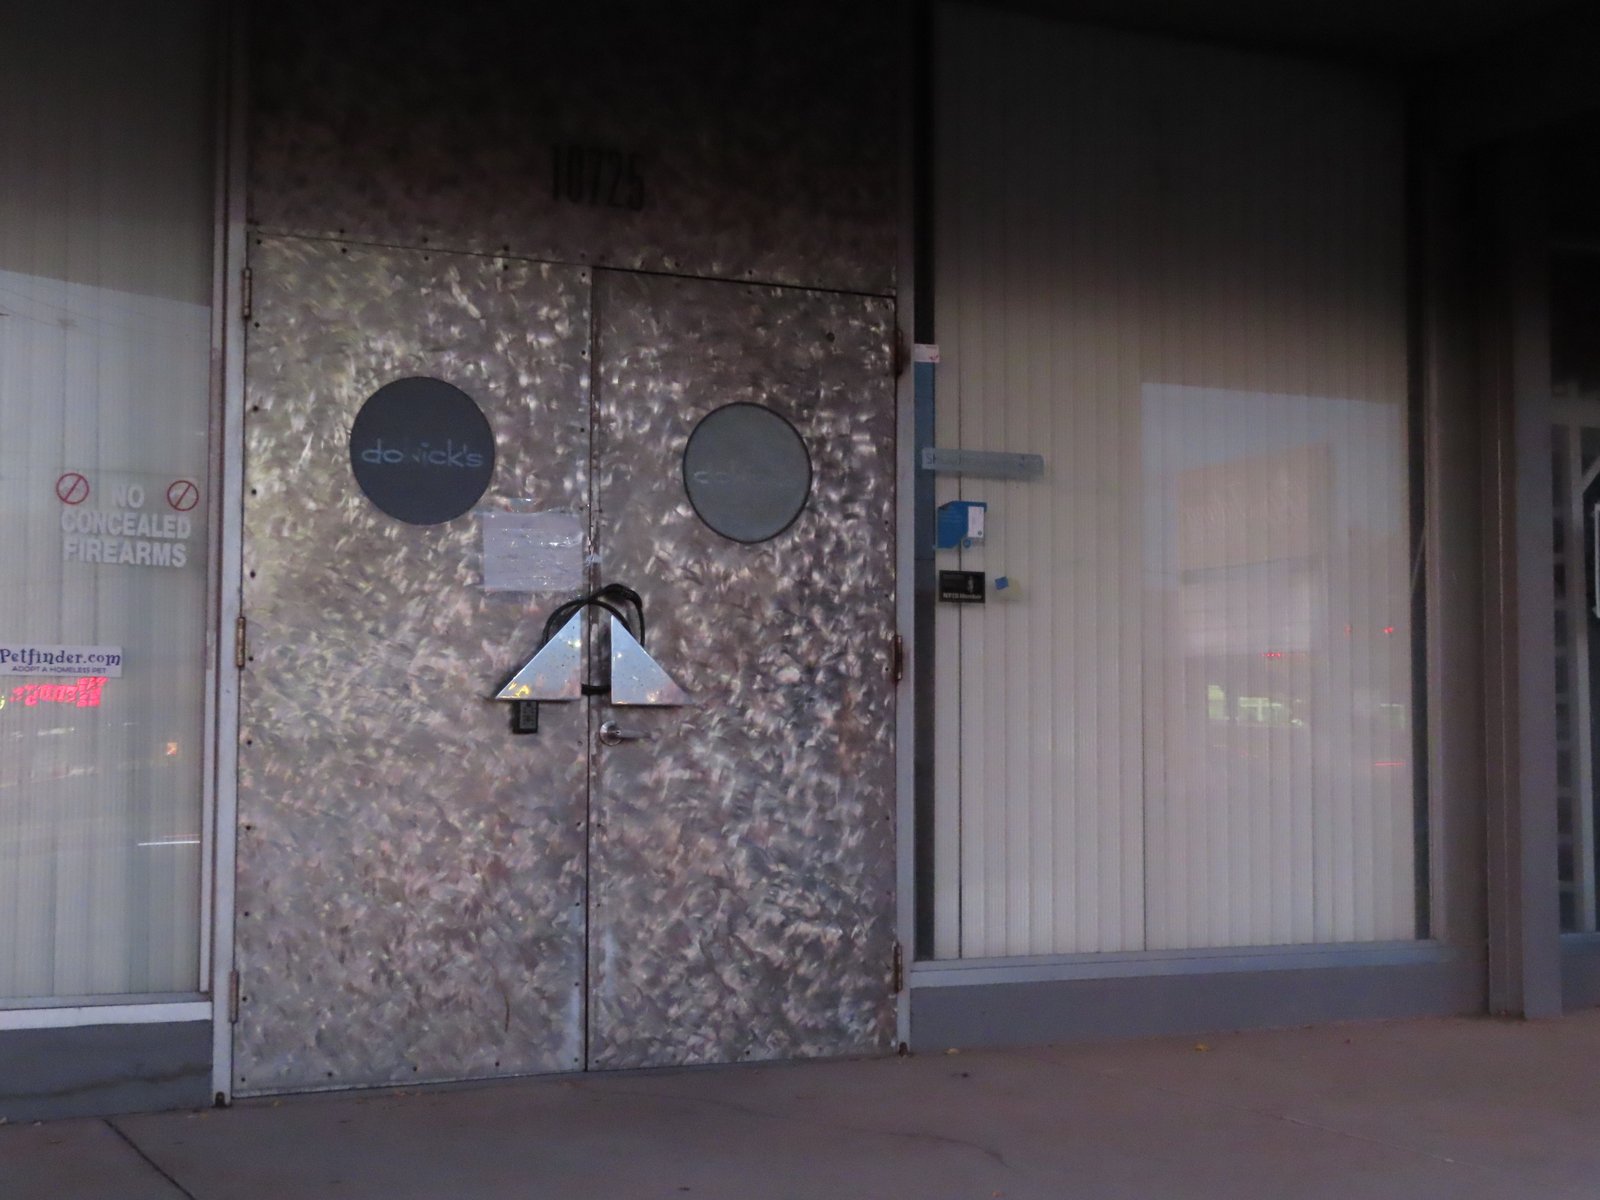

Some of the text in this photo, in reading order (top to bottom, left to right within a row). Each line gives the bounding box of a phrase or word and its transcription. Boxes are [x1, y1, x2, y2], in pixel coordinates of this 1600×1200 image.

[551, 143, 645, 211] 10725
[361, 438, 484, 468] doick's
[112, 484, 145, 509] NO
[61, 508, 192, 539] CONCEALED
[62, 538, 188, 568] FIREARMS
[0, 648, 121, 666] Petfinder.com
